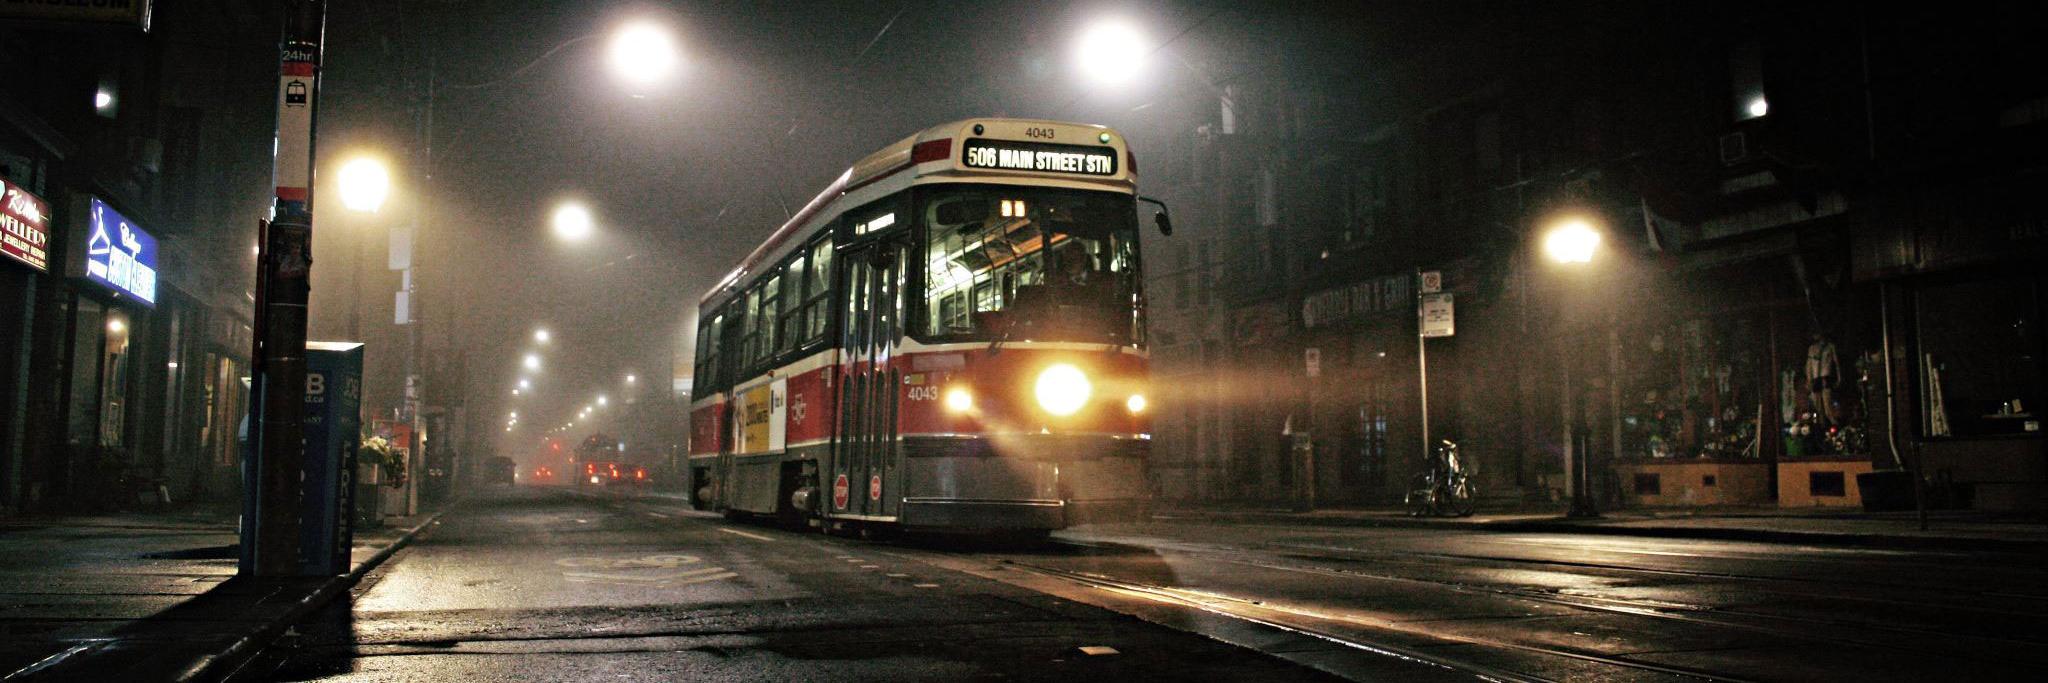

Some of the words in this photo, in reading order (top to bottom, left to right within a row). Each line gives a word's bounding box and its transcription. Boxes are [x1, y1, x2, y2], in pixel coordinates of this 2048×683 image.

[1025, 126, 1055, 140] 4043
[967, 146, 997, 167] 506
[998, 148, 1035, 169] MAIN
[1036, 151, 1086, 173] STREET
[1086, 153, 1112, 174] STN
[907, 385, 938, 402] 4043
